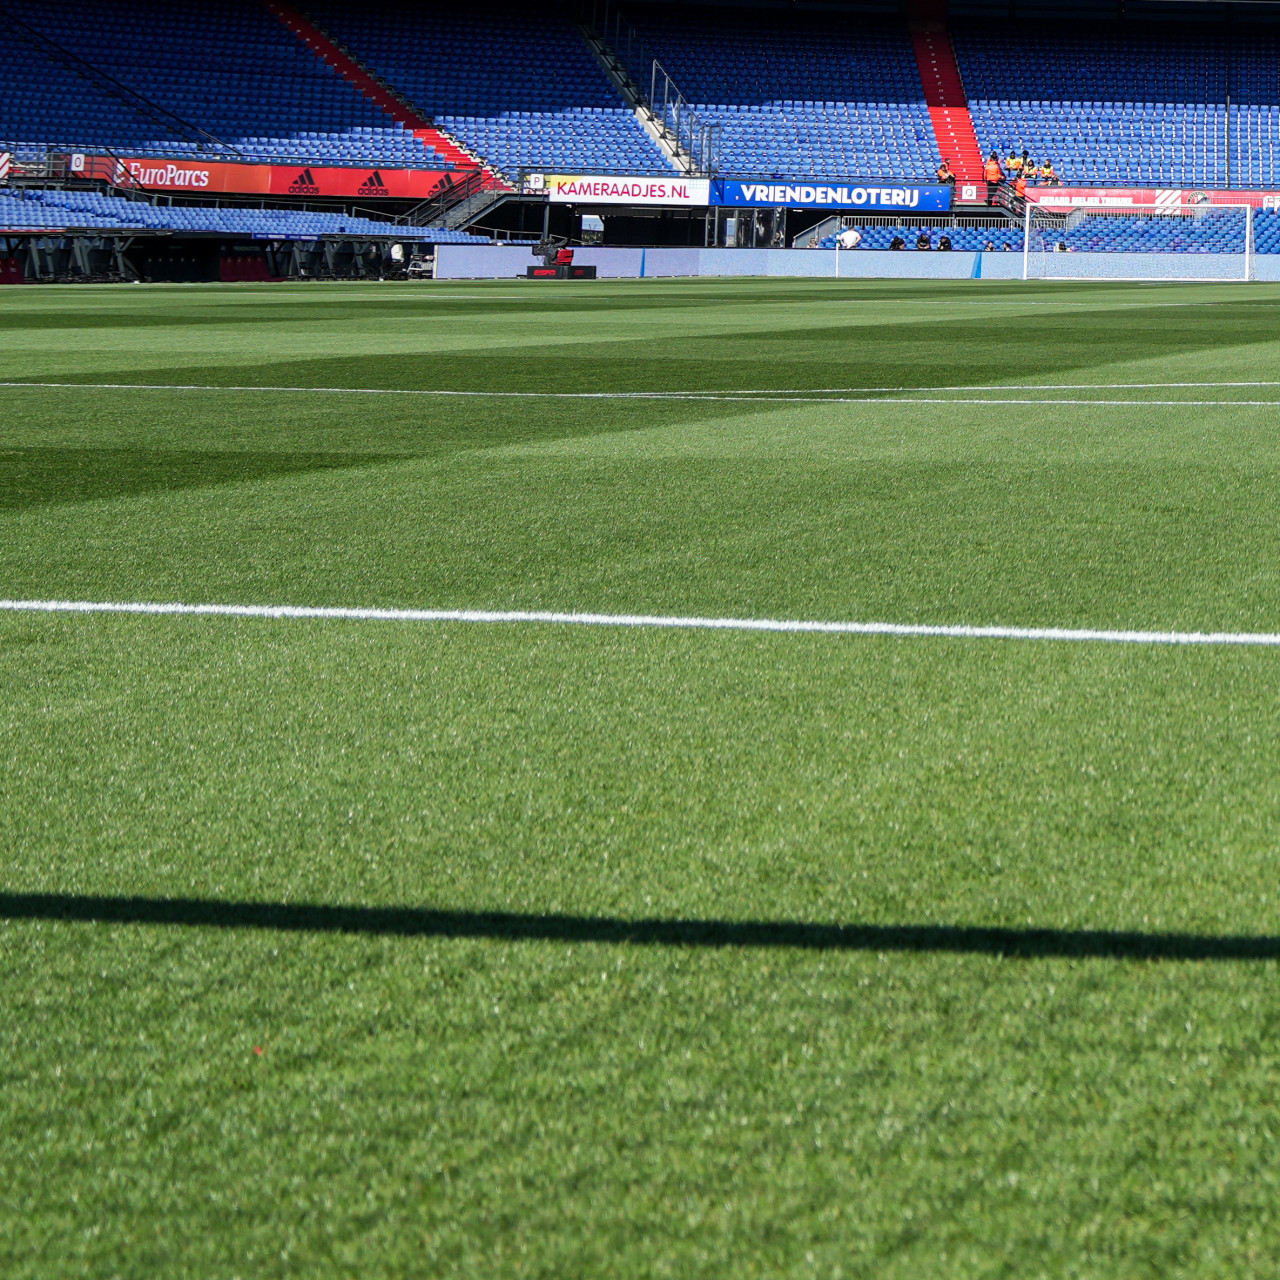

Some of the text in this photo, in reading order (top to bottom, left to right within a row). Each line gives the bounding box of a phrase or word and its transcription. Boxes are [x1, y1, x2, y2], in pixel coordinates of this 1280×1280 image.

[129, 162, 209, 187] EuroParcs
[534, 176, 540, 186] P
[288, 185, 320, 195] adidas
[358, 187, 389, 197] adidas
[557, 181, 691, 199] KAMERAADJES.NL
[740, 183, 920, 209] VRIENDENLOTERIJ
